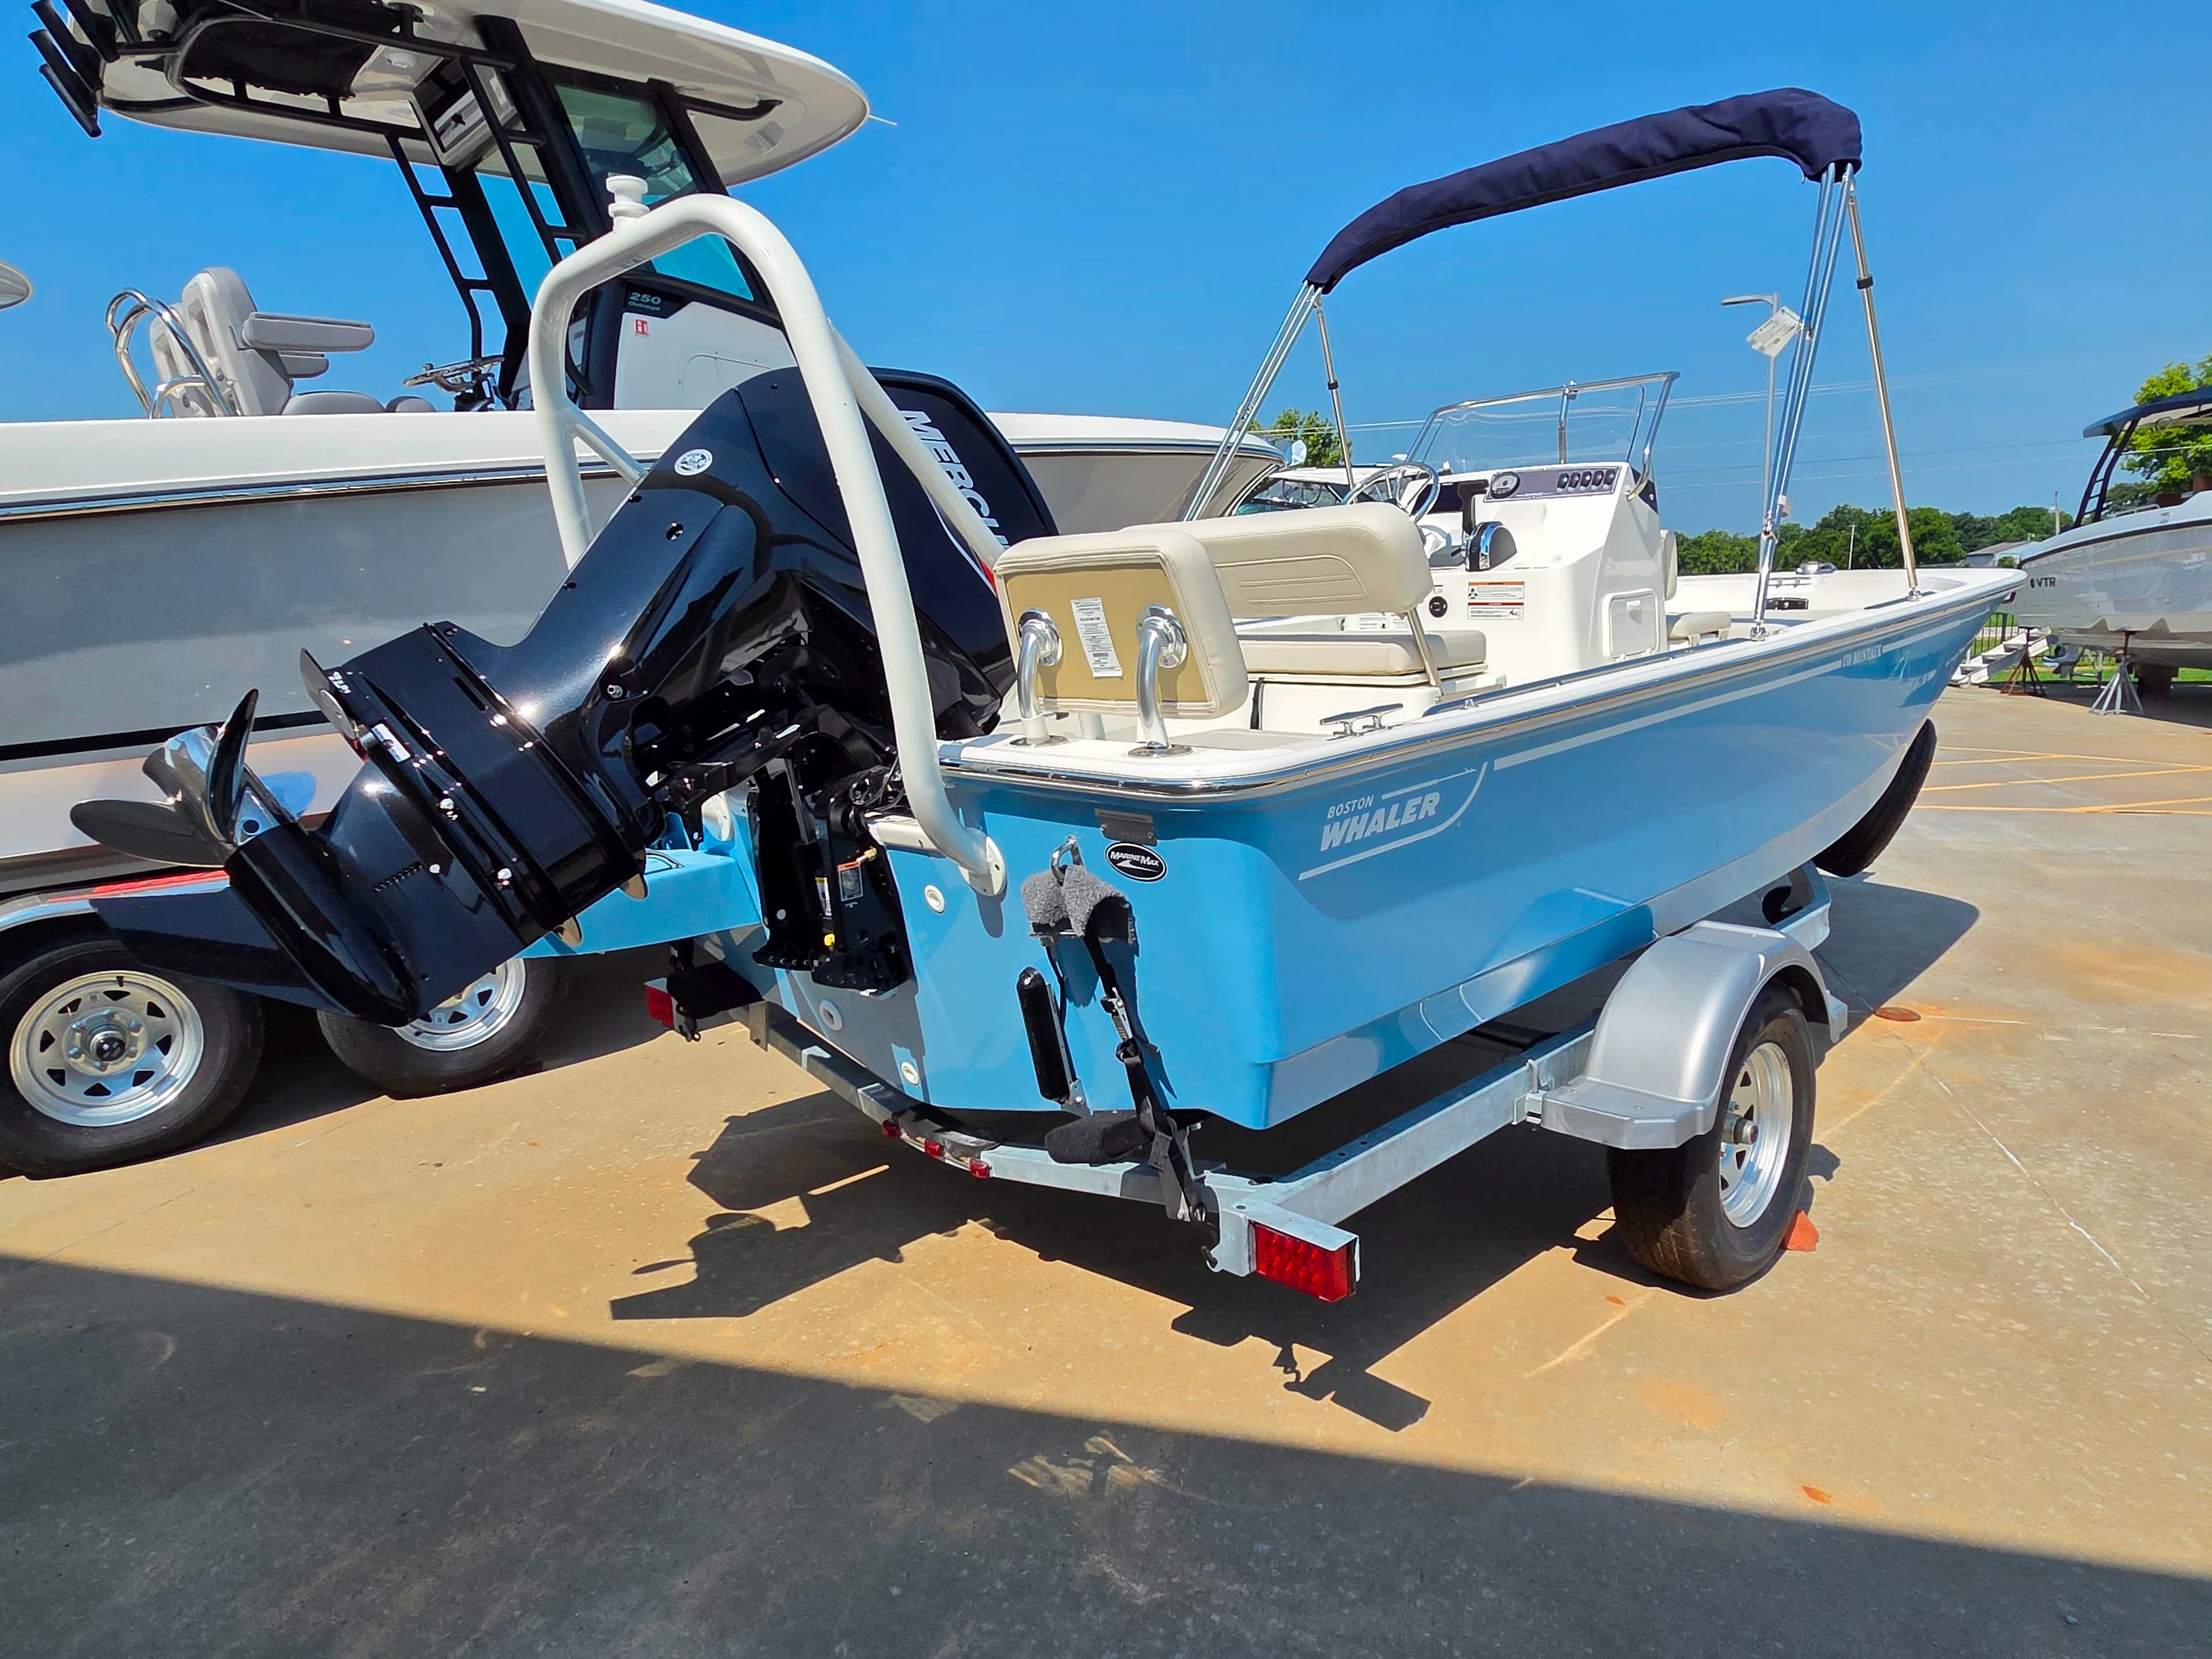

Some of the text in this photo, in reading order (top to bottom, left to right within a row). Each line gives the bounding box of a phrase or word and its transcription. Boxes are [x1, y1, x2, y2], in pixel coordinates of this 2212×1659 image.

[629, 292, 662, 305] 250
[2036, 577, 2056, 588] VTR
[1327, 794, 1374, 819] BOSTON
[1320, 791, 1440, 852] WHALER
